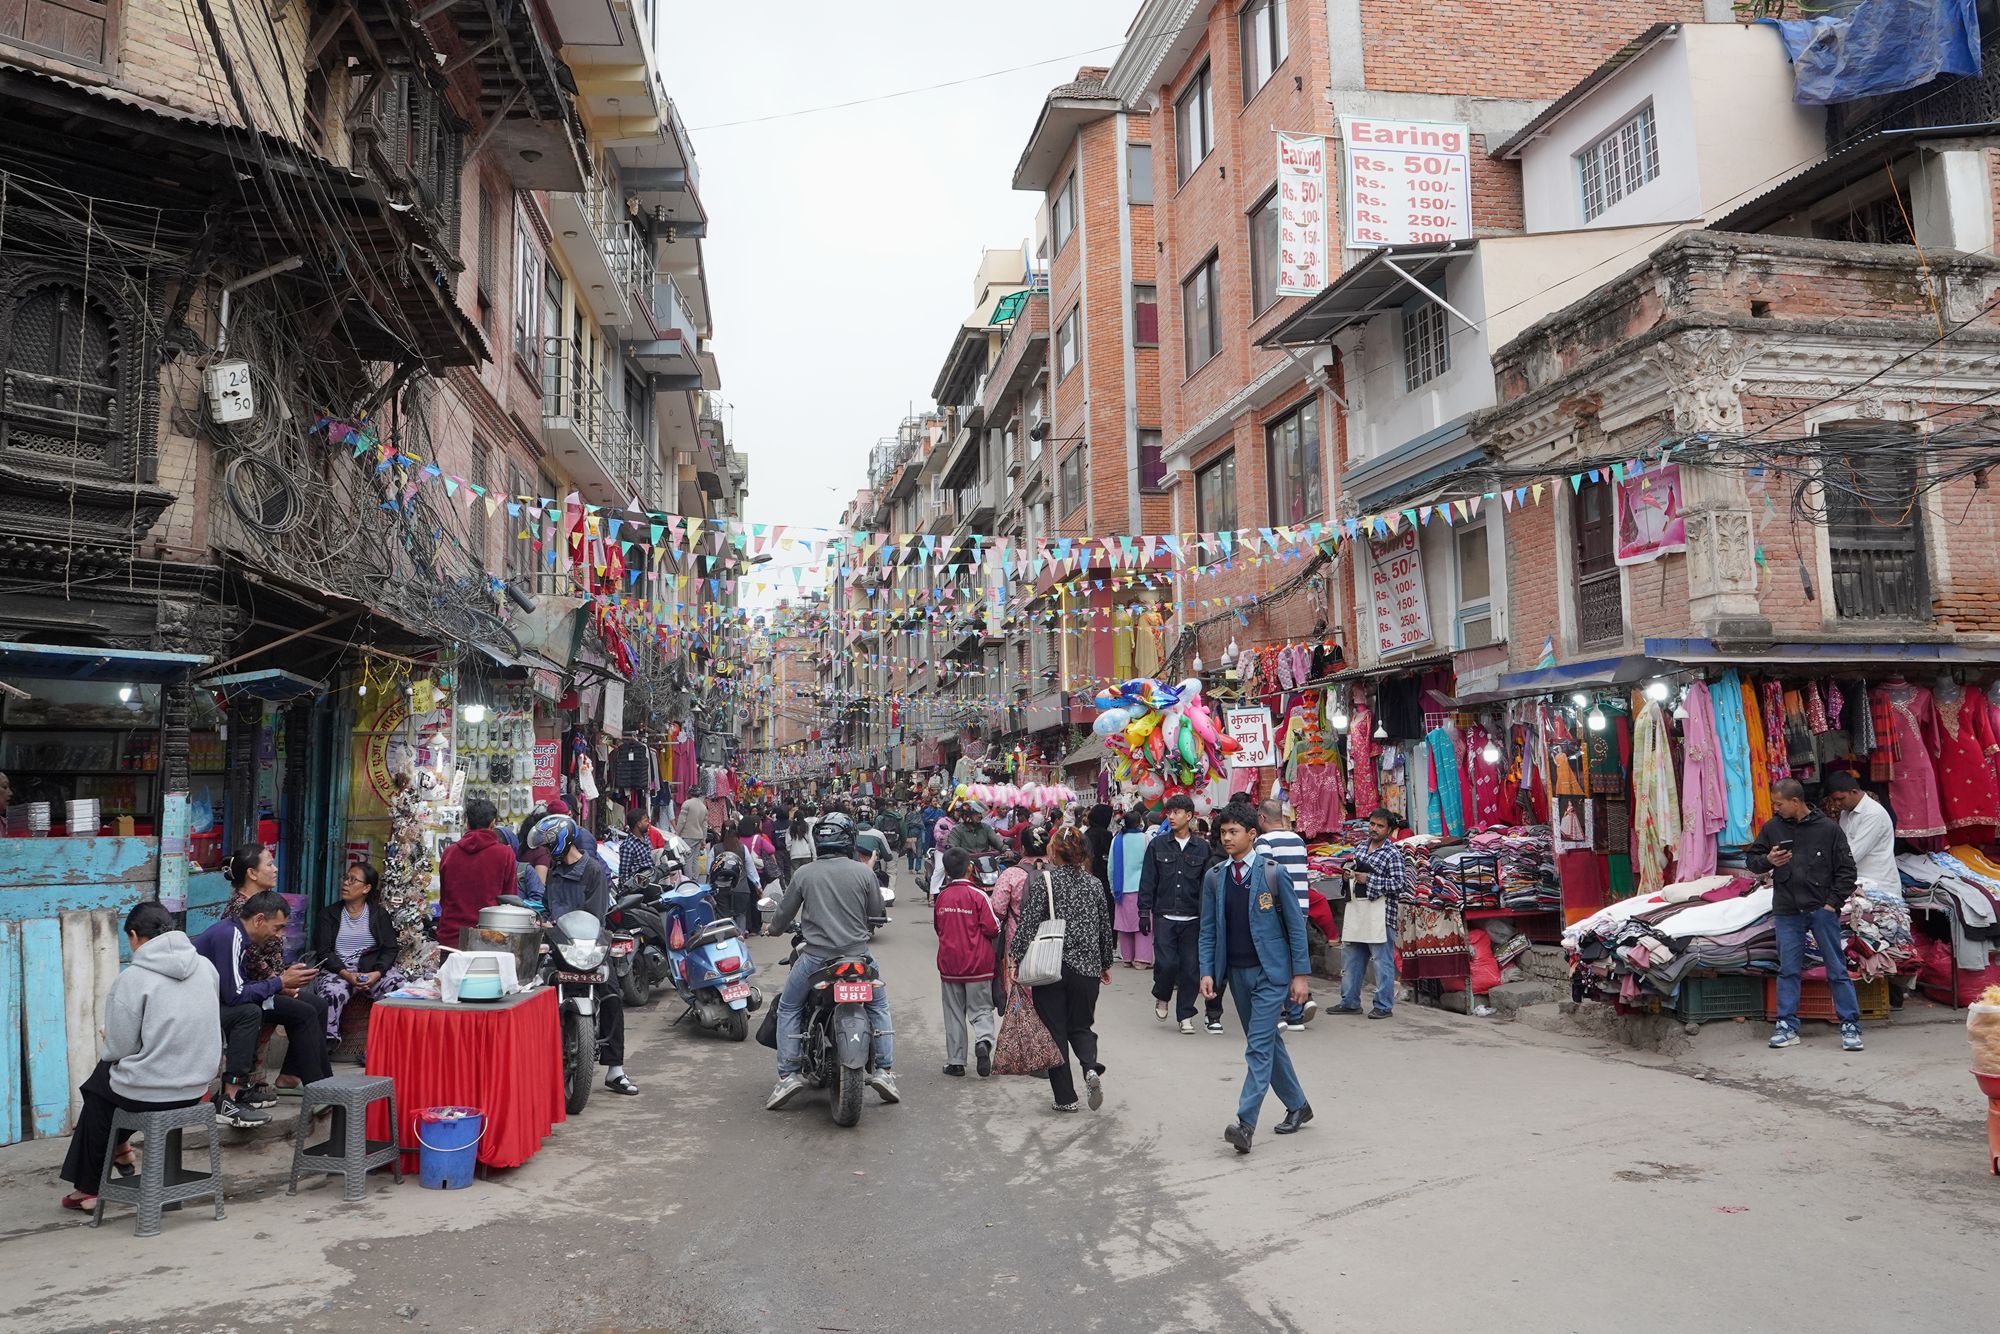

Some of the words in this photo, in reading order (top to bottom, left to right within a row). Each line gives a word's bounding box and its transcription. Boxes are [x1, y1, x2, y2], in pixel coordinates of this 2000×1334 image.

[1351, 122, 1461, 153] Earing
[1281, 141, 1321, 173] Earing
[1354, 155, 1394, 172] Rs.
[1404, 156, 1461, 176] 50/-
[1282, 182, 1297, 202] Rs.
[1301, 181, 1322, 203] 50/-
[1355, 175, 1386, 189] Rs.
[1407, 179, 1456, 193] 100/-
[1356, 192, 1387, 207] Rs.
[1407, 196, 1457, 210] 150/-
[1282, 206, 1295, 222] Rs.
[1357, 210, 1388, 224] Rs.
[1407, 213, 1457, 228] 250/-
[1282, 227, 1296, 243] Rs.
[1357, 228, 1389, 242] Rs.
[1282, 249, 1296, 264] Rs.
[1281, 271, 1295, 286] Rs.
[229, 368, 248, 387] 28
[234, 397, 251, 411] 50
[1374, 571, 1391, 586] Rs.
[1391, 556, 1417, 579] 50/-
[1375, 590, 1390, 602] Rs.
[1395, 579, 1416, 595] 100/-
[1377, 606, 1390, 617] Rs.
[1396, 596, 1418, 611] 150/-
[1379, 622, 1392, 633] Rs.
[1400, 611, 1421, 628] 250/-
[1381, 638, 1394, 649] Rs.
[1400, 628, 1424, 644] 300/-
[1230, 713, 1264, 730] झुम्का
[1236, 732, 1258, 744] मात्र
[372, 744, 383, 767] पूजा
